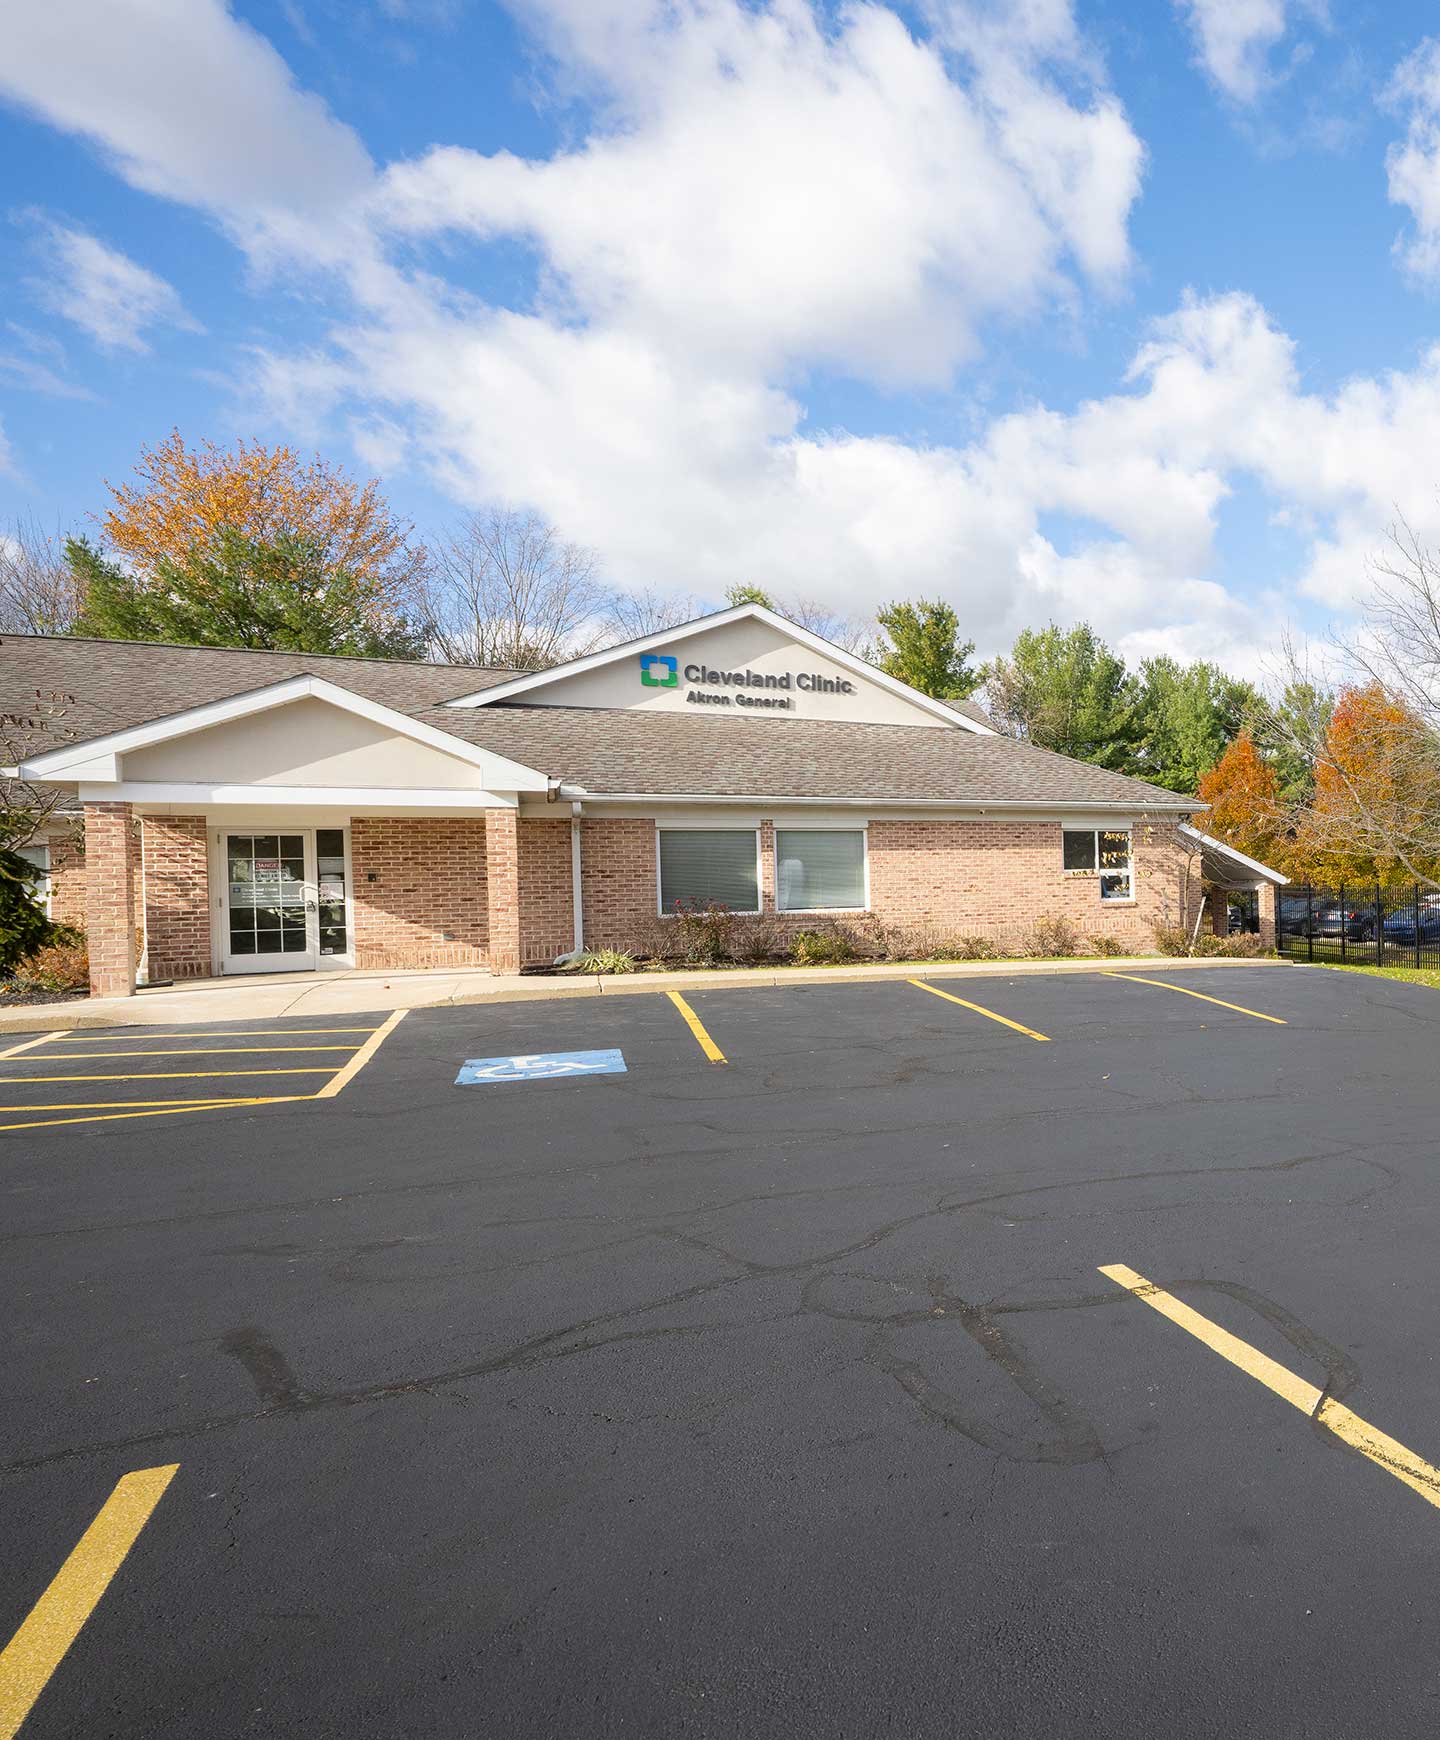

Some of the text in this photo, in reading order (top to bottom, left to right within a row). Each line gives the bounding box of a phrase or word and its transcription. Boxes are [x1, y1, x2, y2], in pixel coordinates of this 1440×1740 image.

[684, 665, 853, 693] Cleveland Clinic
[686, 691, 790, 709] Akron General
